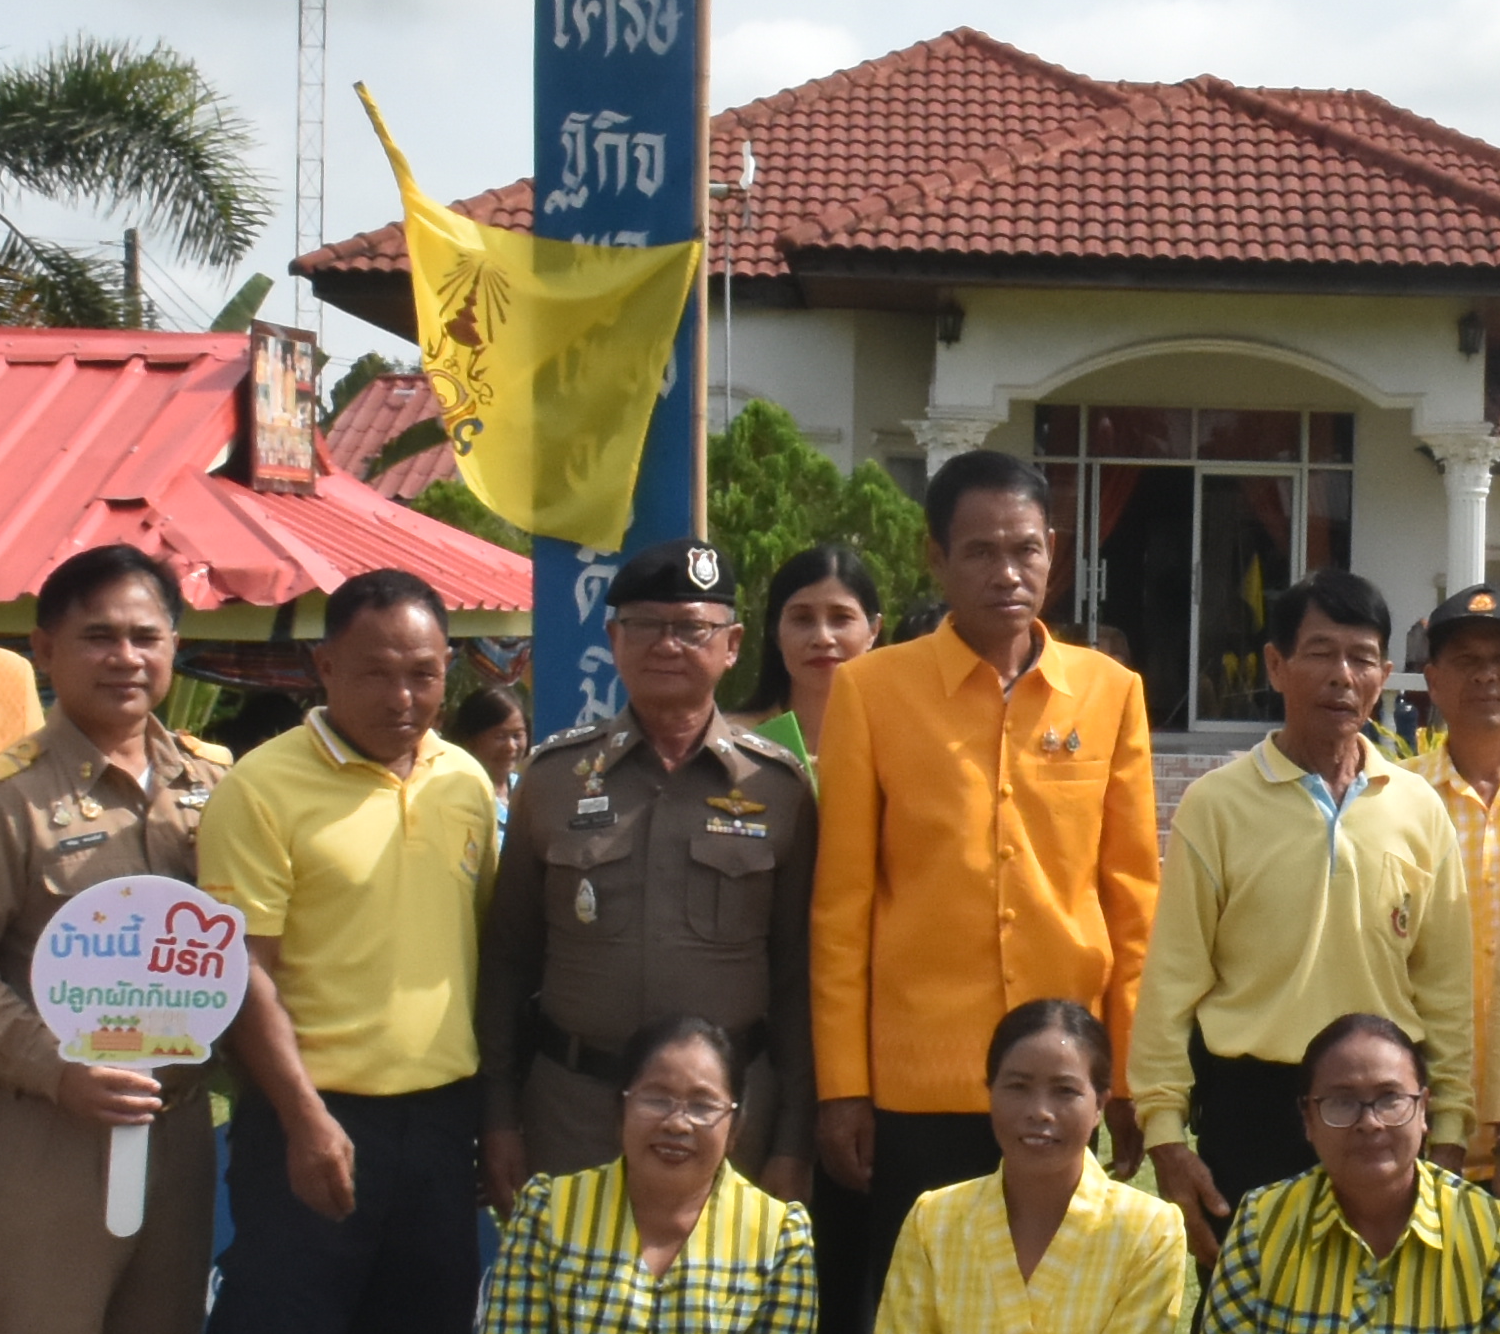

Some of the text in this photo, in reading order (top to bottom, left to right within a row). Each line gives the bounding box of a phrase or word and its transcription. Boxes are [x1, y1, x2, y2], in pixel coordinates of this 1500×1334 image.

[543, 110, 668, 215] ฐกิจ
[50, 913, 225, 980] บ้านนี้ มีรัก
[48, 979, 229, 1014] ปลูกผักกินเอง
